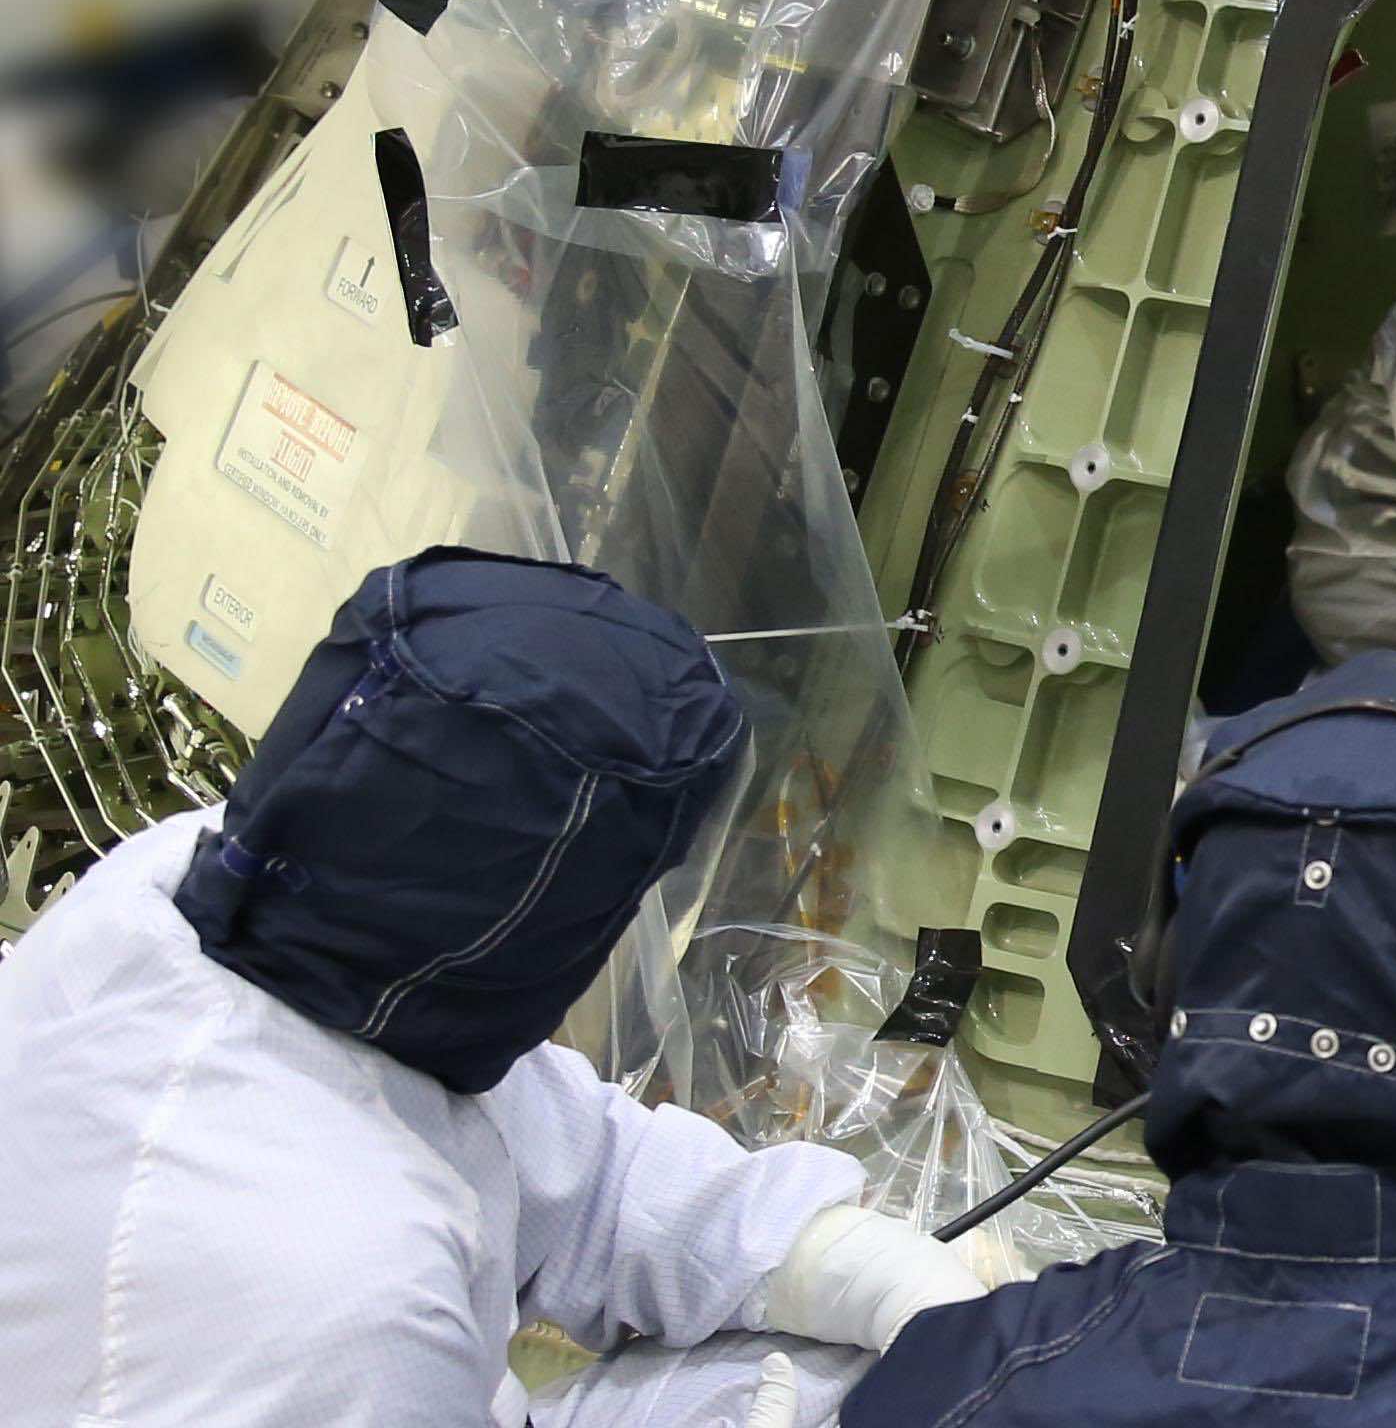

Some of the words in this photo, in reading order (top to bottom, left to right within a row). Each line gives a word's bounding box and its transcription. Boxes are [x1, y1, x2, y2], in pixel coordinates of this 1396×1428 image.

[336, 277, 378, 314] FORWARD
[263, 378, 313, 426] REMOVE
[310, 404, 355, 455] BEFORE
[273, 433, 315, 482] FLIGHT
[214, 586, 255, 628] EXTERIOR
